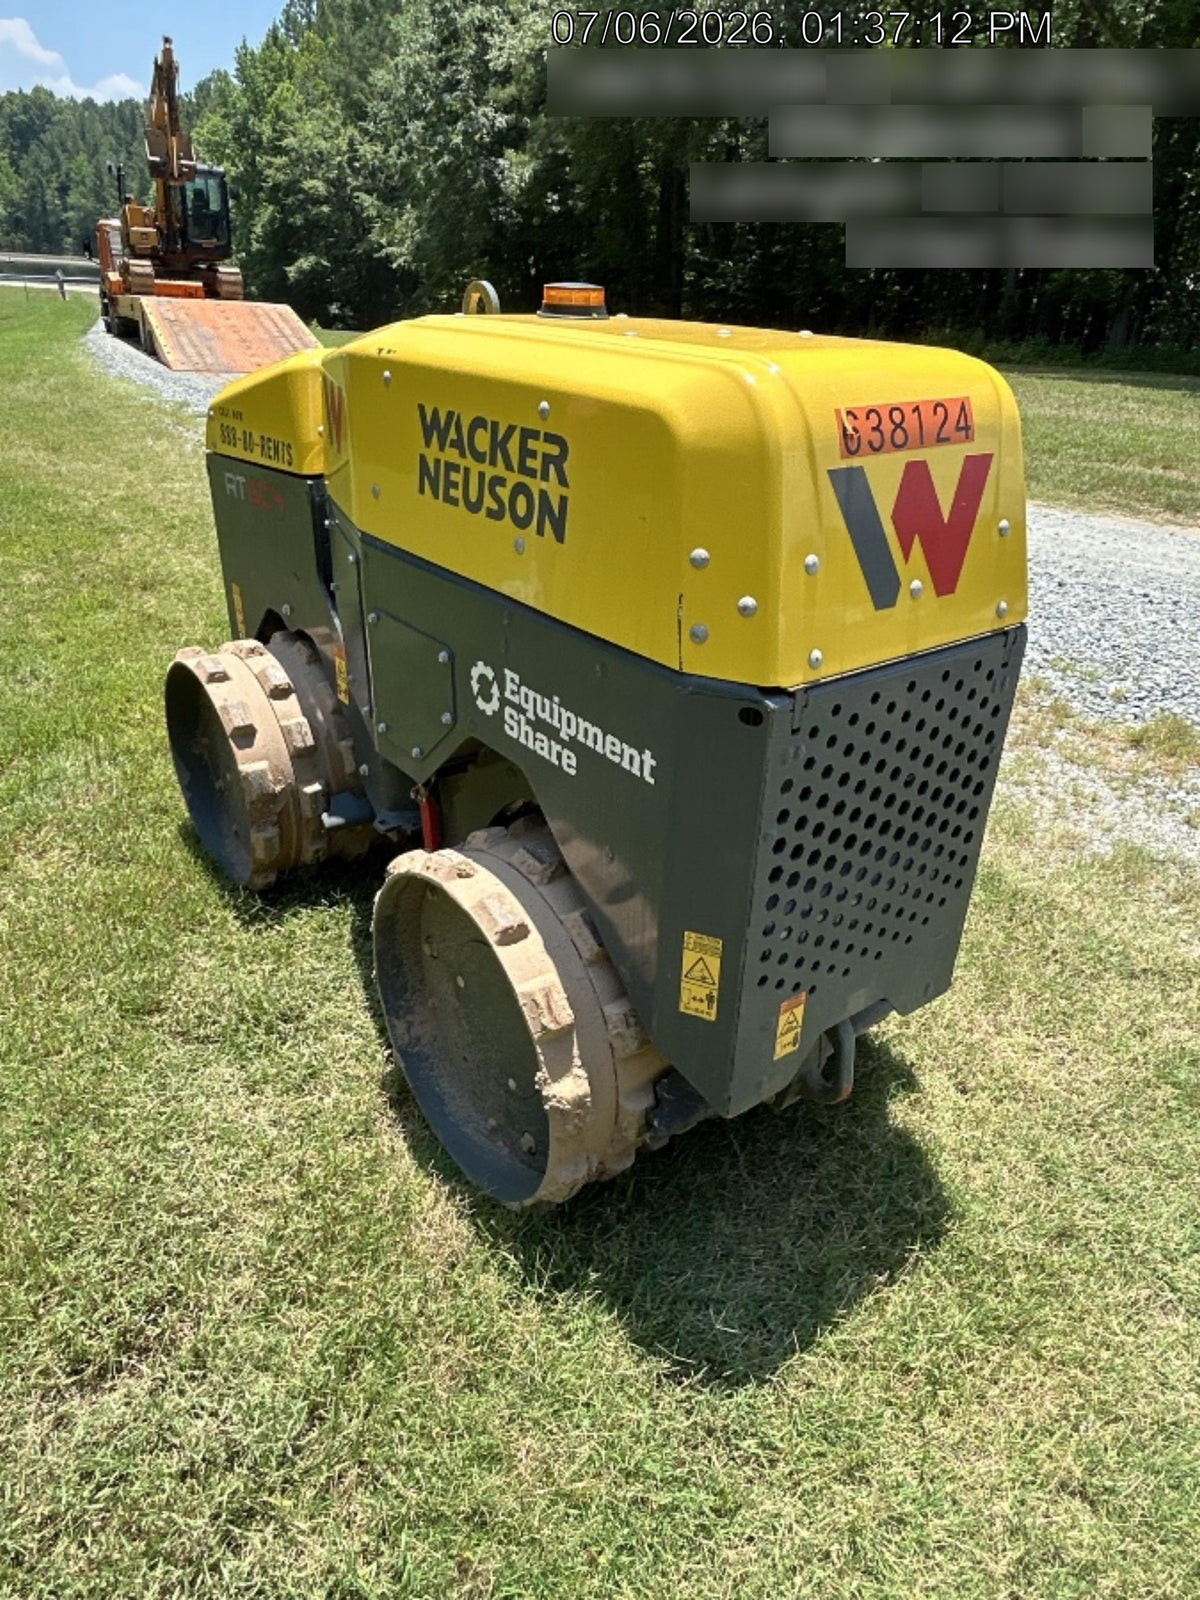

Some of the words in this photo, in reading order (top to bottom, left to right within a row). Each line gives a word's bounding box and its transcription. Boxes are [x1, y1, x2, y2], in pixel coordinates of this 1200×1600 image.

[417, 402, 570, 489] WACKER
[842, 400, 972, 456] 638124
[418, 452, 569, 545] NEUSON
[503, 667, 657, 785] Equipment
[503, 705, 577, 776] Share
